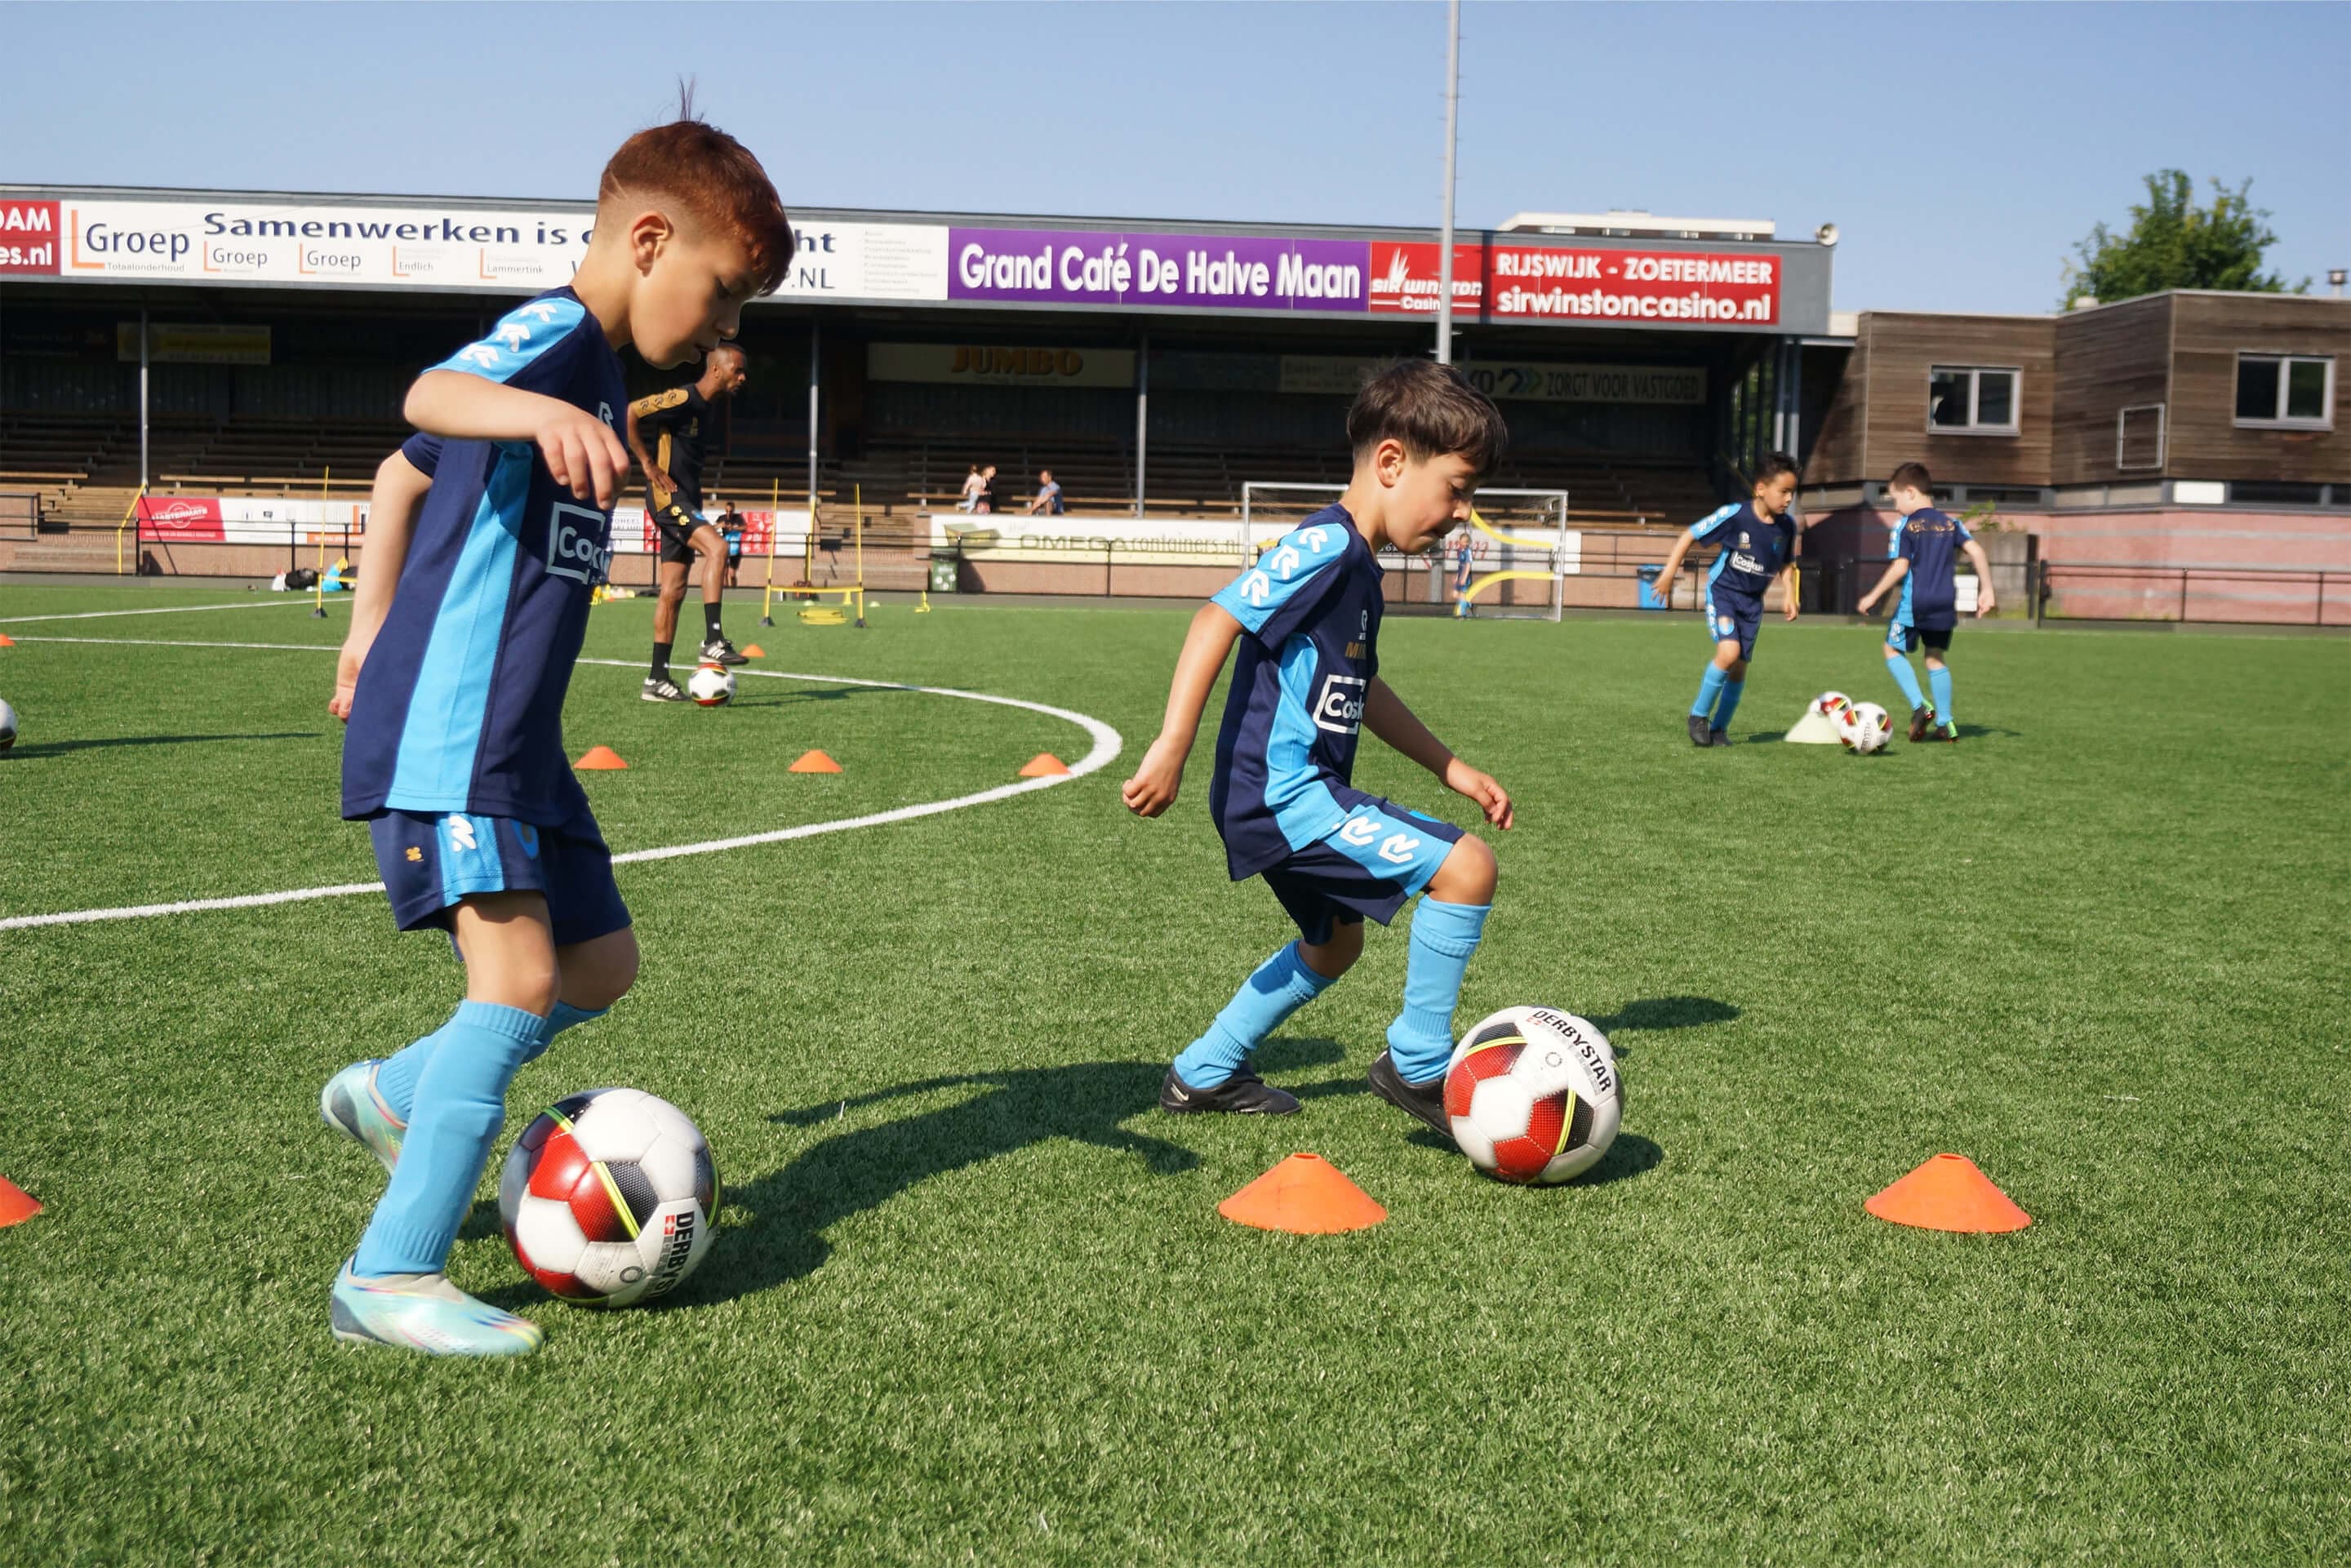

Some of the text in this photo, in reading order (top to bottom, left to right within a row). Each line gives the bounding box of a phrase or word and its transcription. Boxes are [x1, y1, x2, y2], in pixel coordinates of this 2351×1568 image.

[0, 207, 51, 232] AM
[204, 212, 521, 244] Samenwerken
[536, 221, 569, 246] is
[86, 222, 191, 263] Groep
[107, 261, 185, 273] Totaalonderhoud
[212, 247, 269, 269] Groep
[306, 249, 362, 271] Groep
[398, 260, 434, 272] Endlich
[487, 263, 544, 276] Lammertink
[959, 242, 1361, 299] Grand Café De Halve Maan
[1496, 253, 1602, 279] RIJSWIJK
[1624, 256, 1773, 285] ZOETERMEER
[1400, 295, 1442, 311] Casin
[1496, 285, 1772, 321] sirwinstoncasino.nl
[950, 345, 1084, 377] JUMBO
[1546, 371, 1588, 397] ZORGT
[1593, 372, 1629, 398] VOOR
[1631, 374, 1700, 400] VASTGOED
[1533, 1010, 1612, 1092] DERBYSTAR
